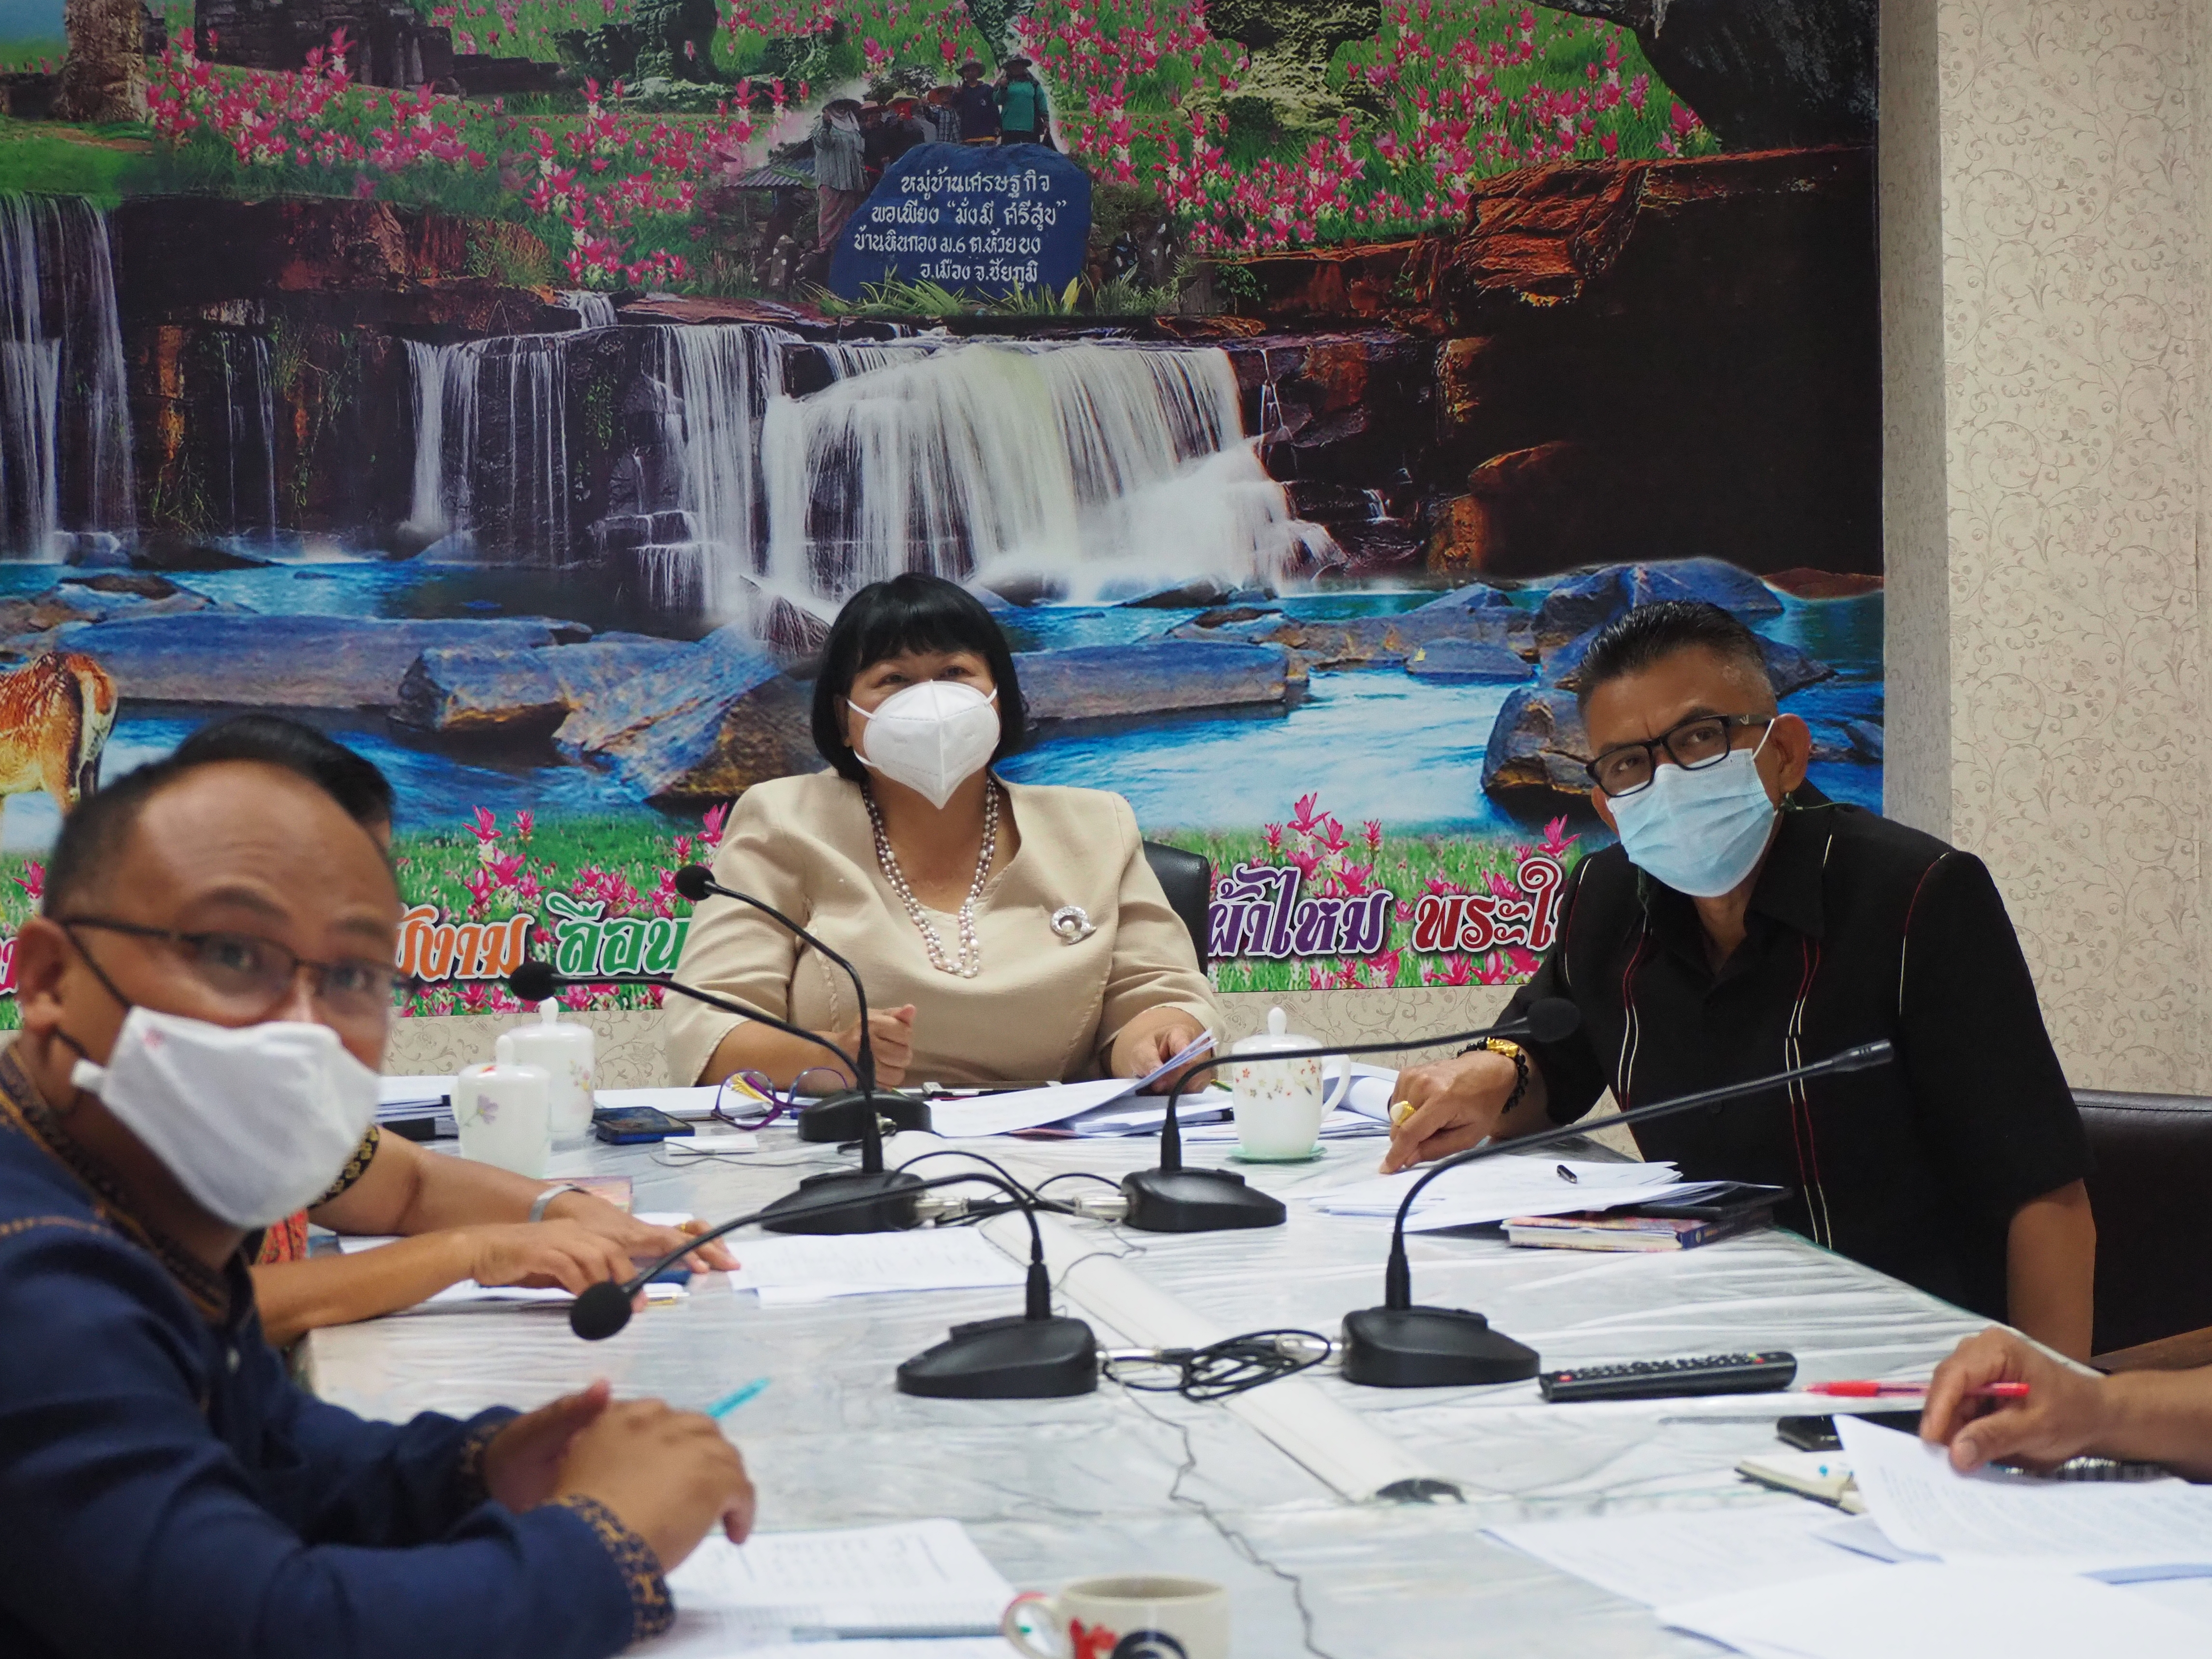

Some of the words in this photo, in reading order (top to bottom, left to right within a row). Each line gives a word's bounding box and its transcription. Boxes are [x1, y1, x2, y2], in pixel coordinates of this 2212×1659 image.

[871, 200, 939, 225] พอเพียง
[920, 258, 971, 280] อ.เมือง
[1412, 856, 1566, 952] พระใ
